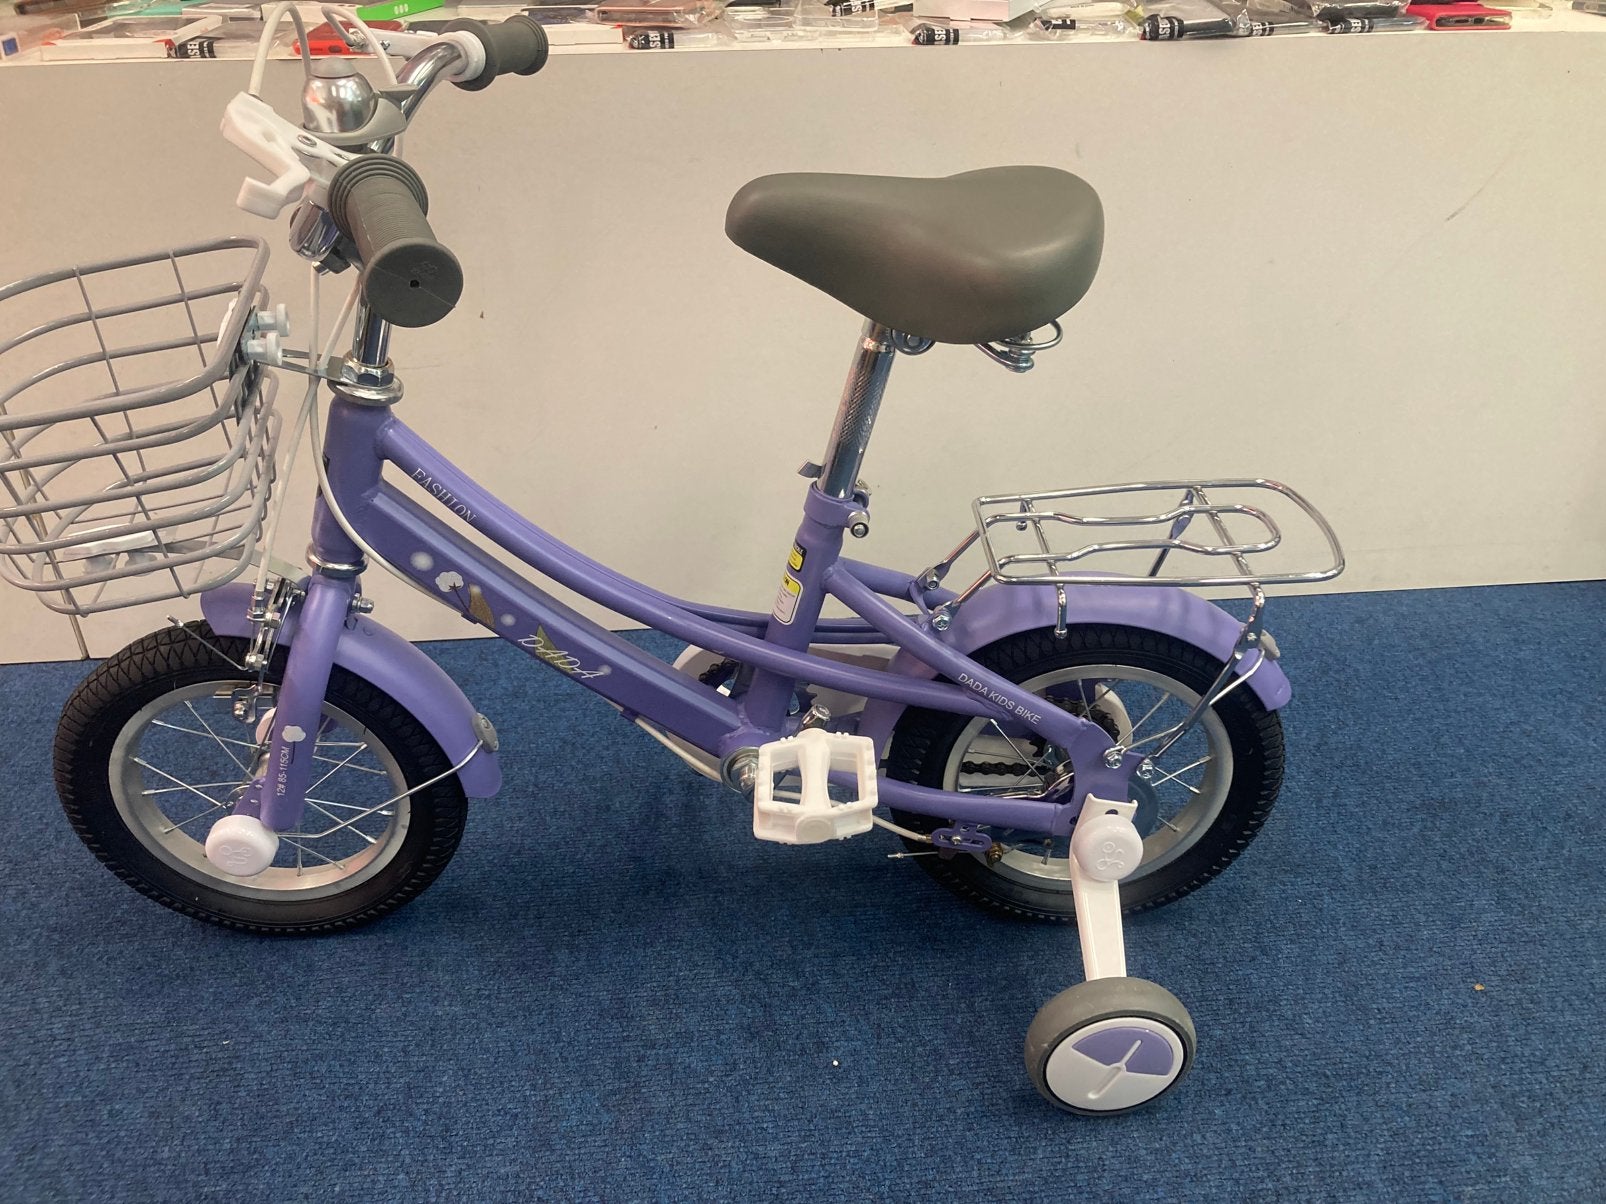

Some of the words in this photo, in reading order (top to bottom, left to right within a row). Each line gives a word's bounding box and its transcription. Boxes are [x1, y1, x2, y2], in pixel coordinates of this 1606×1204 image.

[411, 467, 477, 522] FASHION
[958, 673, 987, 696] DADA
[988, 690, 1016, 710] KIDS
[1014, 705, 1042, 725] BIKE
[278, 746, 290, 782] 85-115CM
